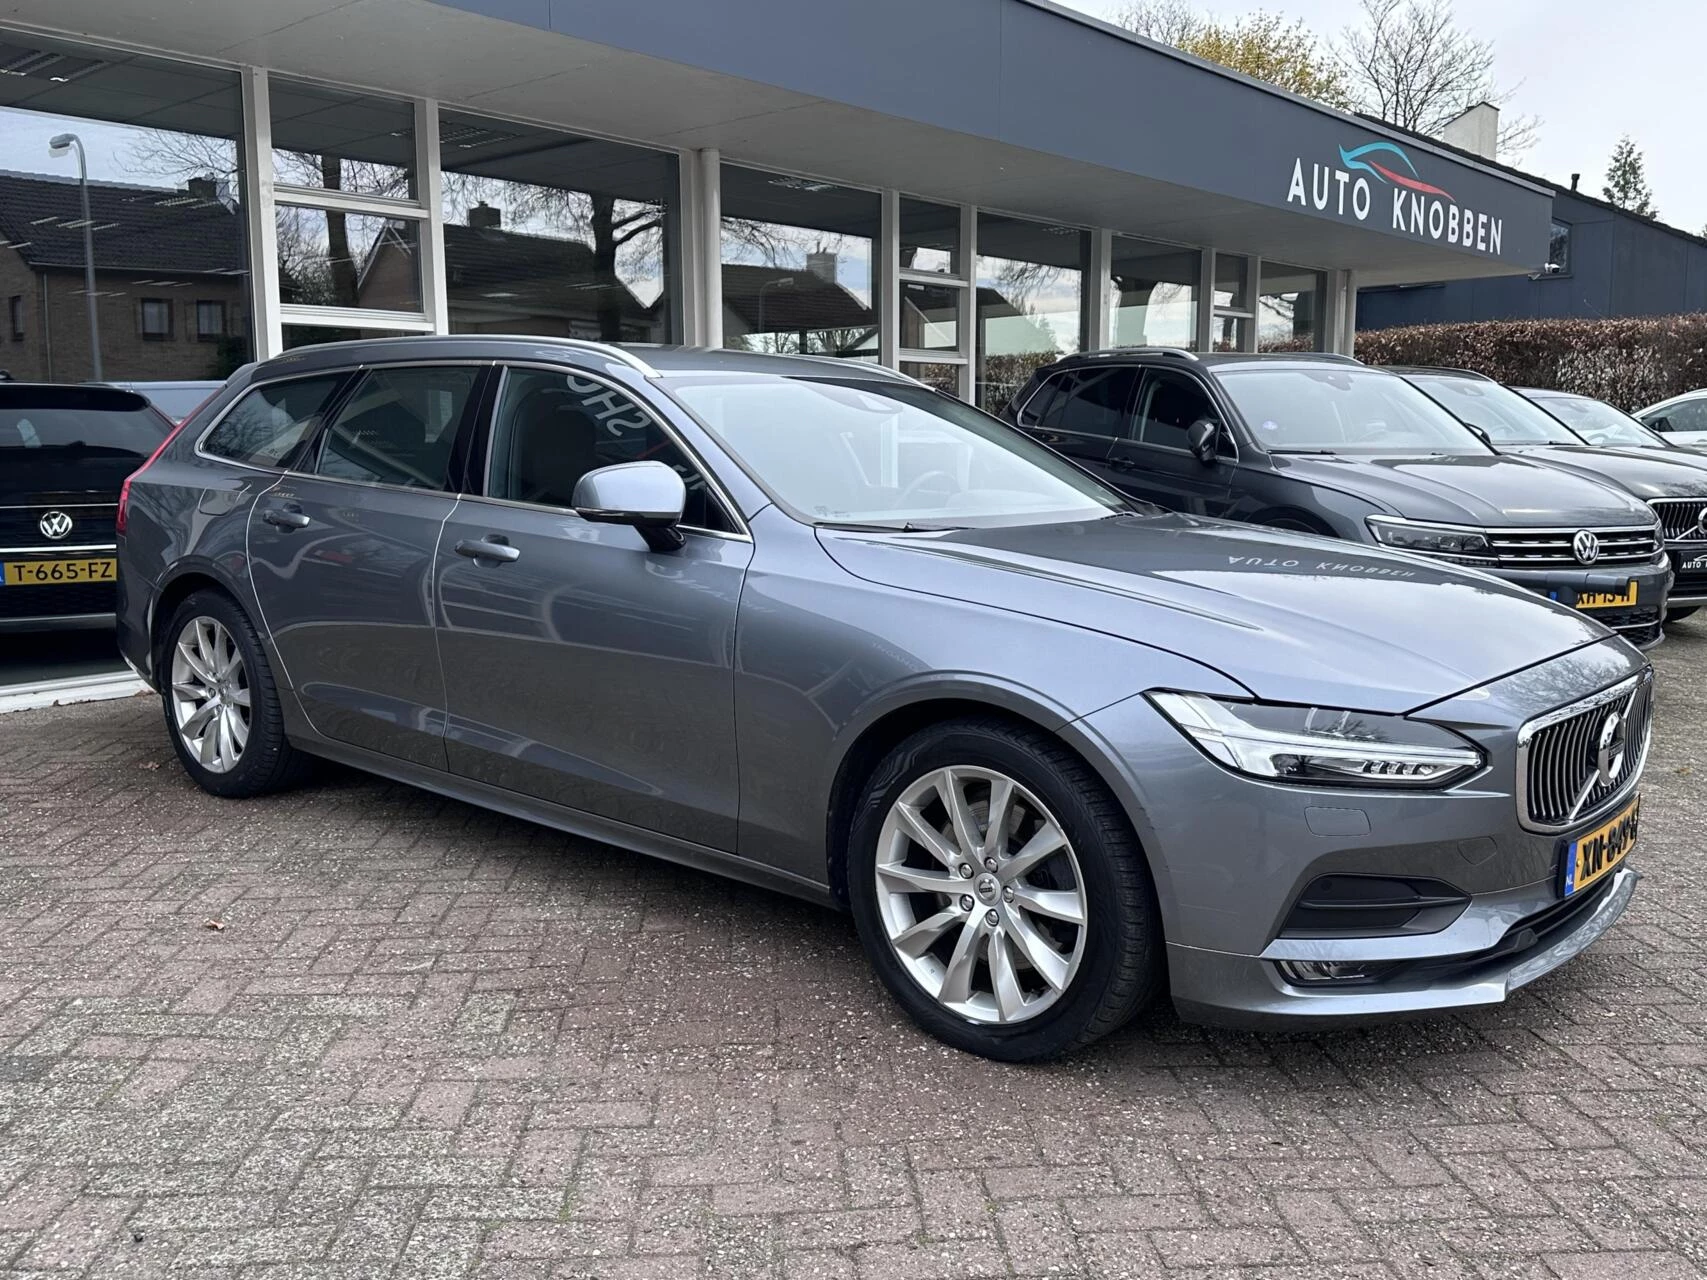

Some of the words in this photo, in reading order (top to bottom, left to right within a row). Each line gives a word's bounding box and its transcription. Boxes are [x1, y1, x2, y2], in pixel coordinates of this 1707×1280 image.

[1287, 157, 1371, 221] AUTO
[1392, 187, 1503, 255] KNOBBEN
[13, 562, 112, 581] T-665-FZ
[1682, 561, 1702, 569] AUTO
